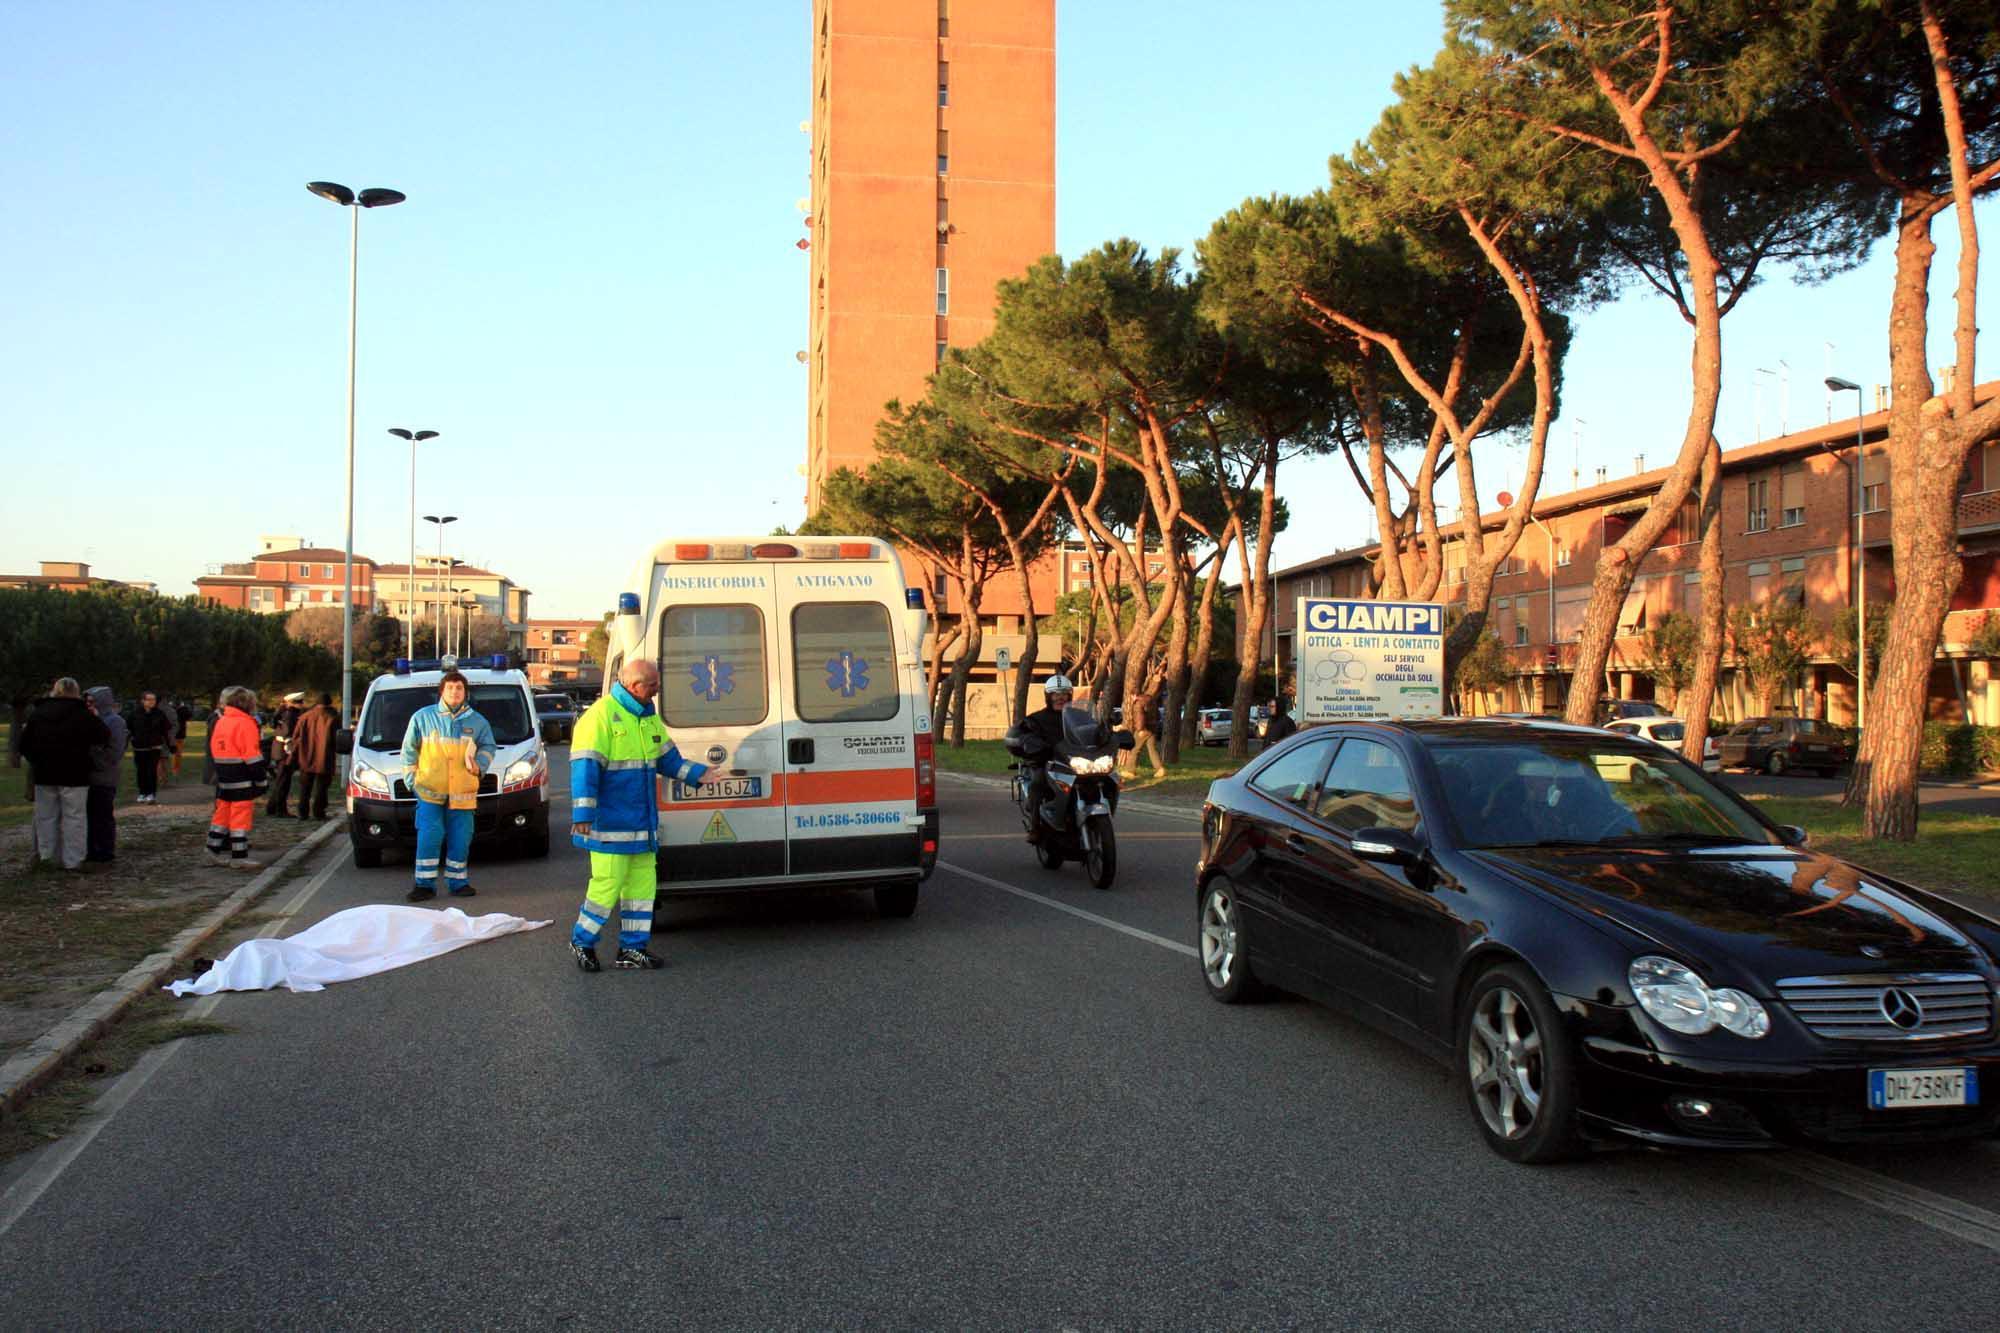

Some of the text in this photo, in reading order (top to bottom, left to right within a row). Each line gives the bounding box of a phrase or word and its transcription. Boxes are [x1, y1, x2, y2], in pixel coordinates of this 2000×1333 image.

[662, 575, 874, 589] MISERICORDIA ANTIGNANO
[1309, 604, 1439, 632] CIAMPI
[1308, 636, 1342, 648] OTTICA
[1353, 637, 1380, 648] LENTI
[1383, 639, 1390, 648] A
[1392, 638, 1440, 650] CONTATTO
[1383, 655, 1425, 663] SELF SERVICE
[1395, 664, 1414, 672] DEGLI
[1375, 673, 1433, 682] OCCHIALI DA SOLE
